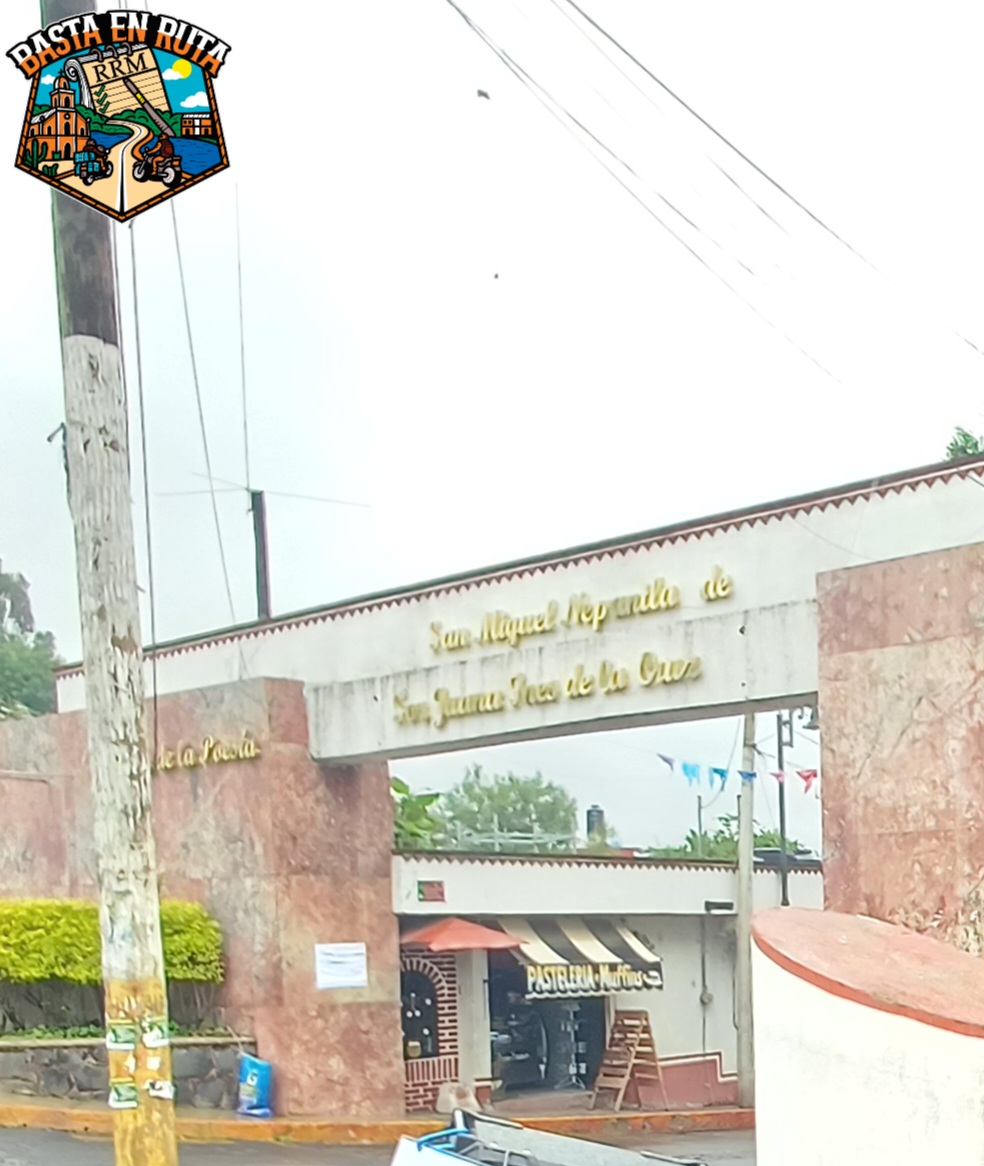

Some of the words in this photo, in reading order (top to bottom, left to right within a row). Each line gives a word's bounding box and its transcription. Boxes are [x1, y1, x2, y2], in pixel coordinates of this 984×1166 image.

[430, 621, 470, 653] San
[478, 599, 559, 648] Miguel
[700, 565, 734, 602] de
[432, 687, 504, 729] Juana
[566, 664, 594, 699] de
[599, 659, 629, 694] la
[177, 740, 196, 768] la
[526, 964, 597, 993] PASTELERIA
